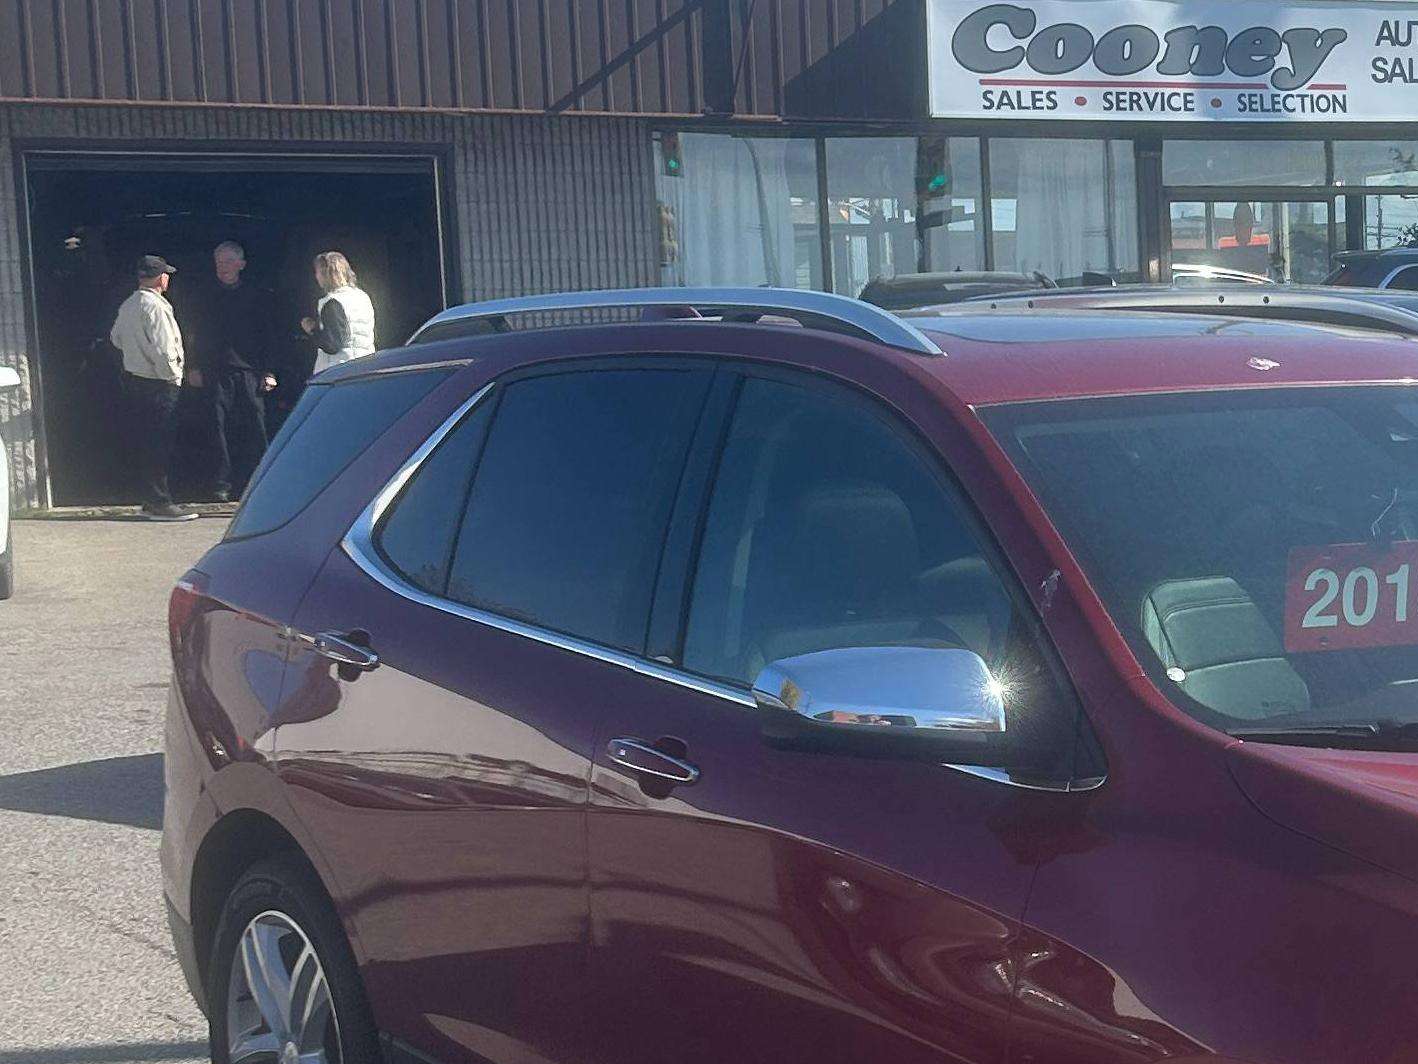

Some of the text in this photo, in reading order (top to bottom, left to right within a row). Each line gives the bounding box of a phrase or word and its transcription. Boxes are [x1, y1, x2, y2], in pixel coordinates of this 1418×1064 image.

[951, 3, 1348, 91] Cooney
[982, 90, 1348, 115] SALES SERVICE SELECTION
